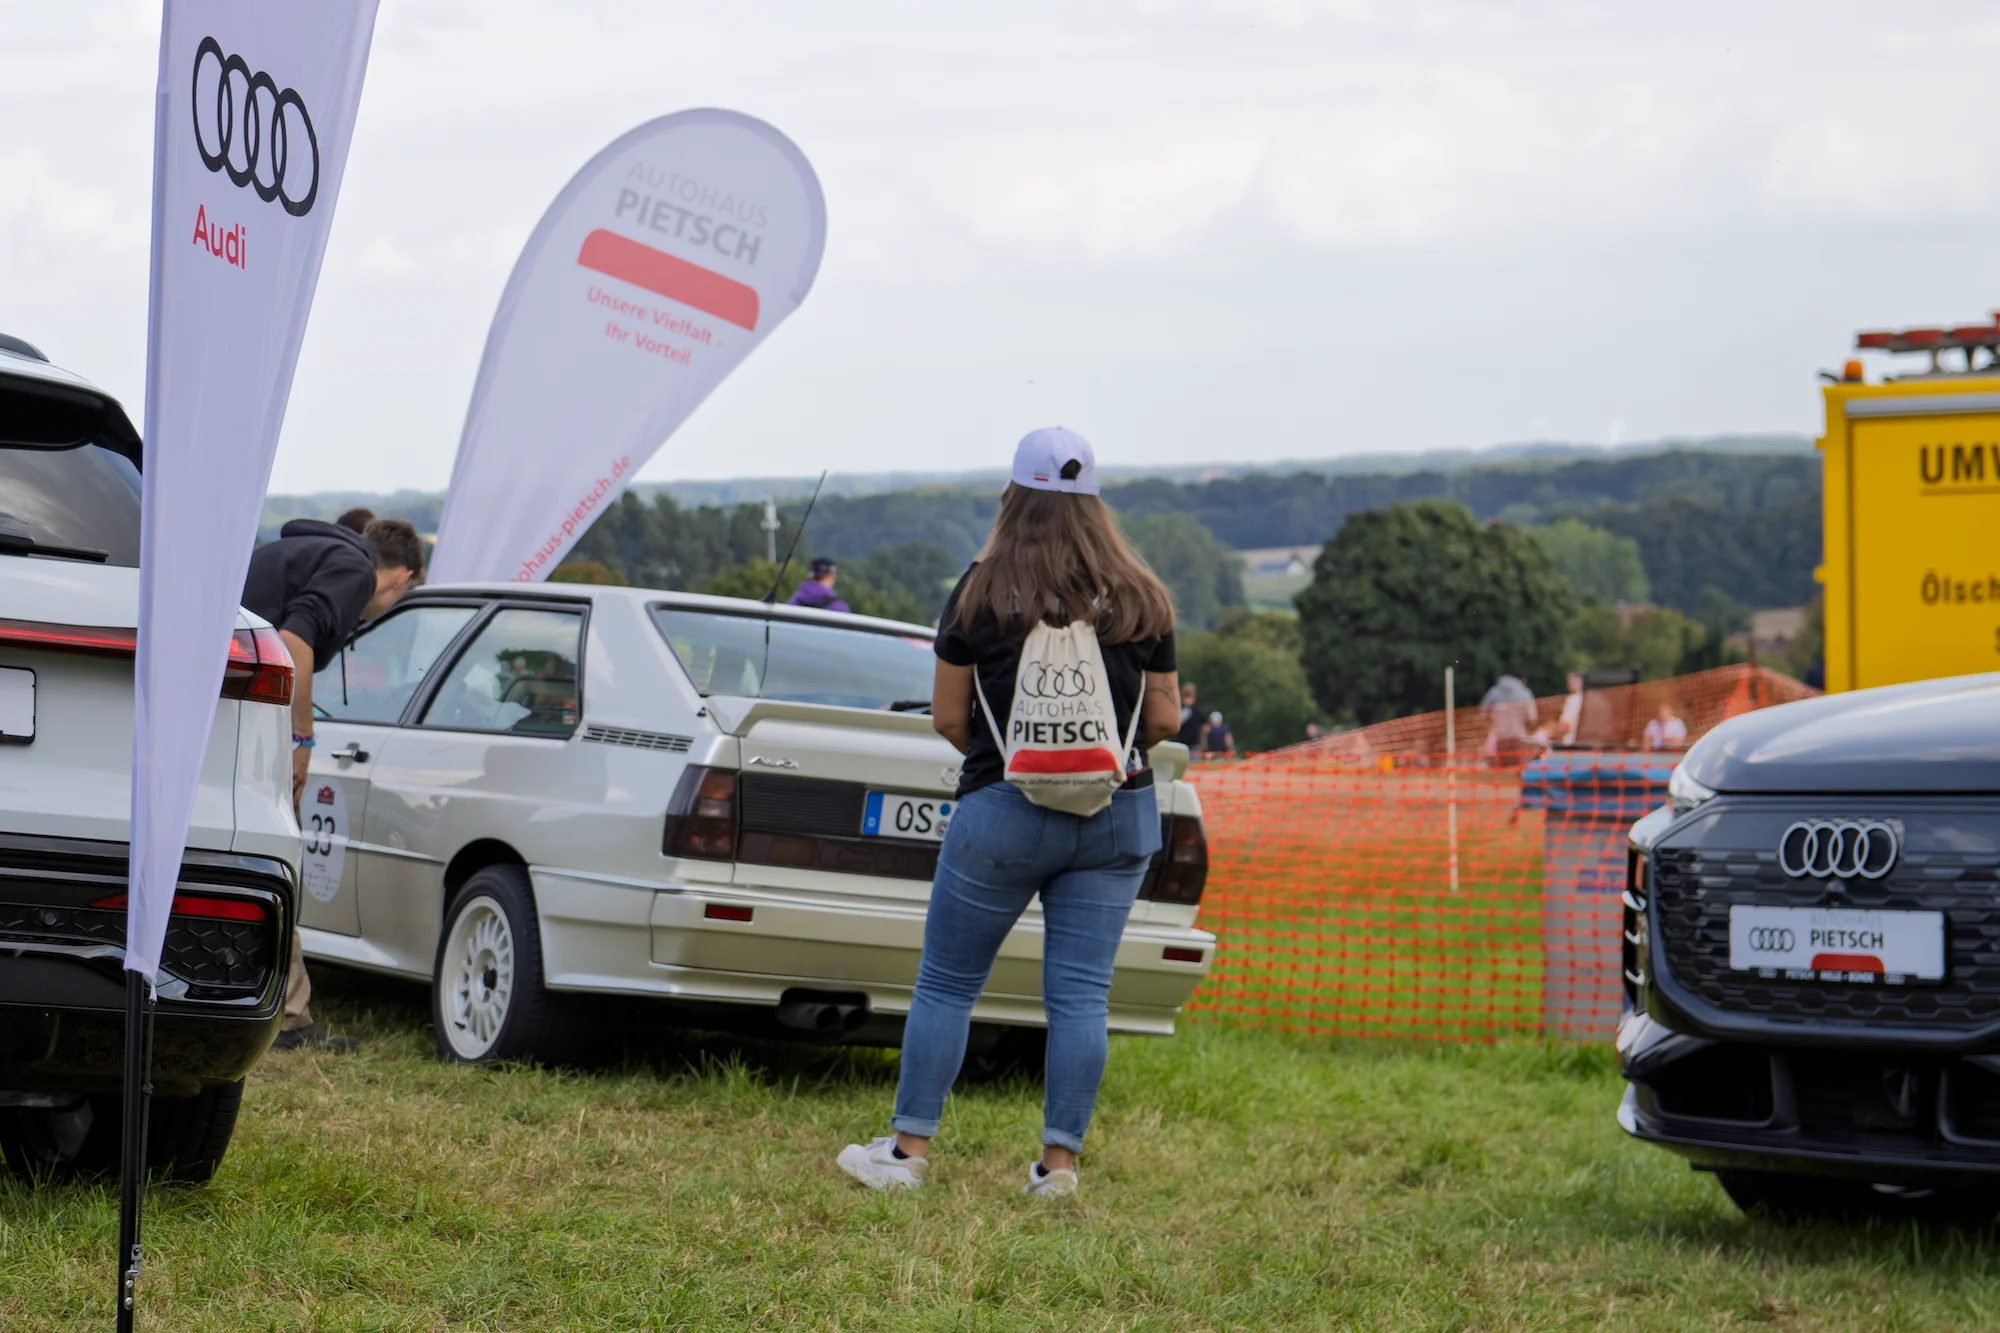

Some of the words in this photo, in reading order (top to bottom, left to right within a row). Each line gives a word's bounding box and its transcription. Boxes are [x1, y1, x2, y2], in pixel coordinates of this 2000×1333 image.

[627, 160, 770, 230] AUTOHAUS
[192, 204, 246, 269] Audi
[615, 187, 761, 266] PIETSCH
[587, 285, 648, 321] Unsere
[652, 308, 713, 346] Vielfalt
[604, 321, 631, 343] Ihr
[635, 331, 693, 366] Vorteil
[1920, 444, 2000, 485] UM
[510, 454, 632, 583] ohaus-pietsch.de
[1013, 720, 1109, 745] PIETSCH
[307, 814, 336, 857] 33
[895, 800, 935, 834] OS
[1809, 911, 1883, 929] AUTOHAUS
[1810, 929, 1884, 949] PIETSCH
